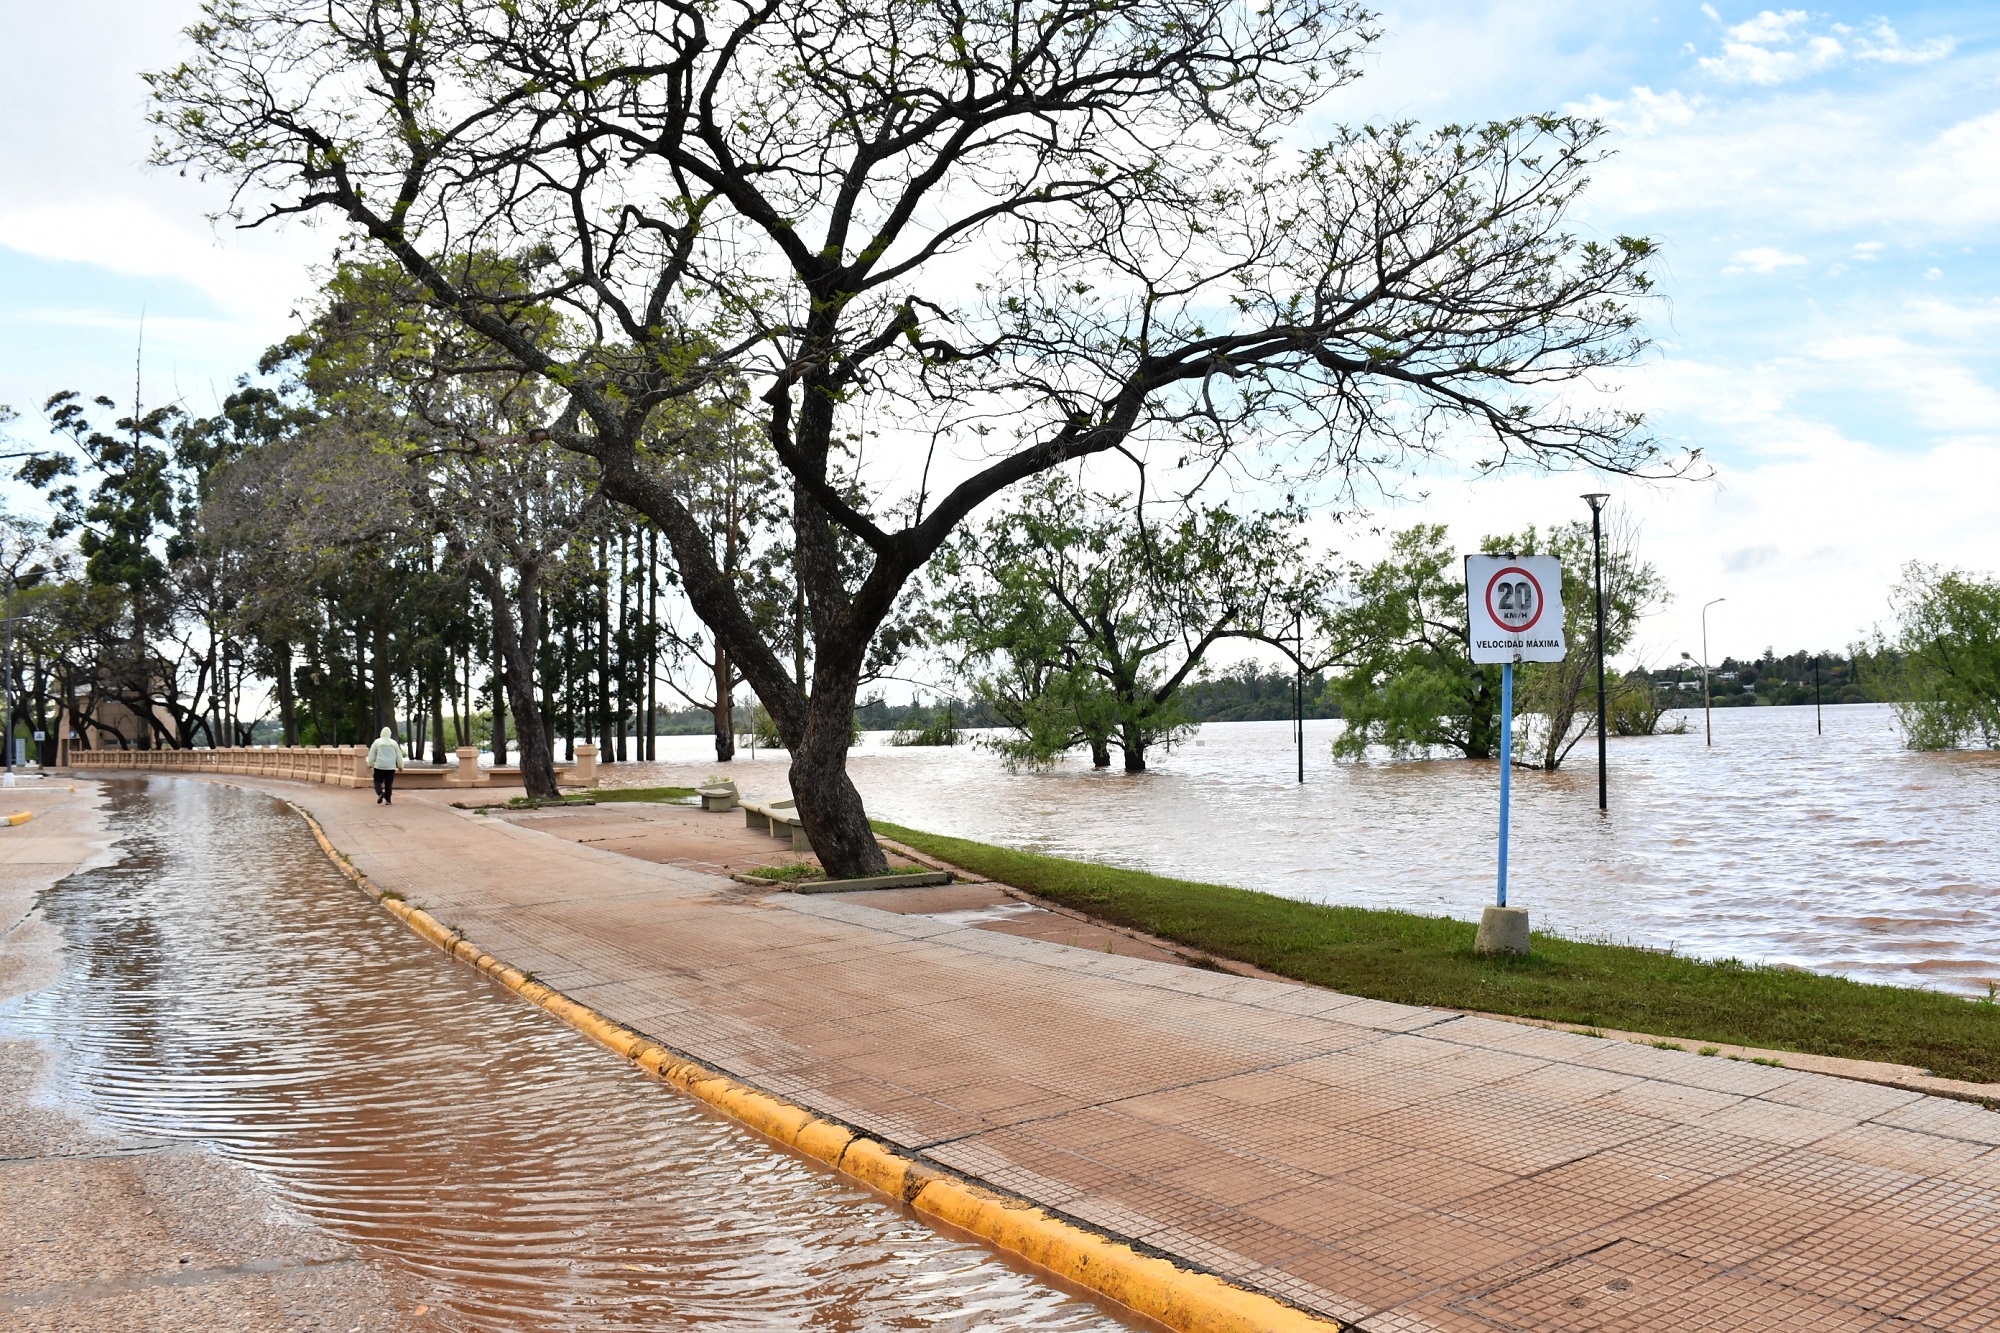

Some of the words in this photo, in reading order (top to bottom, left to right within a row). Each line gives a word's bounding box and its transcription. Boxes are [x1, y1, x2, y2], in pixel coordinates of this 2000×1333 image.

[1498, 582, 1532, 610] 20
[1476, 640, 1524, 649] VELOCIDAD
[1526, 638, 1560, 648] MÁXIMA
